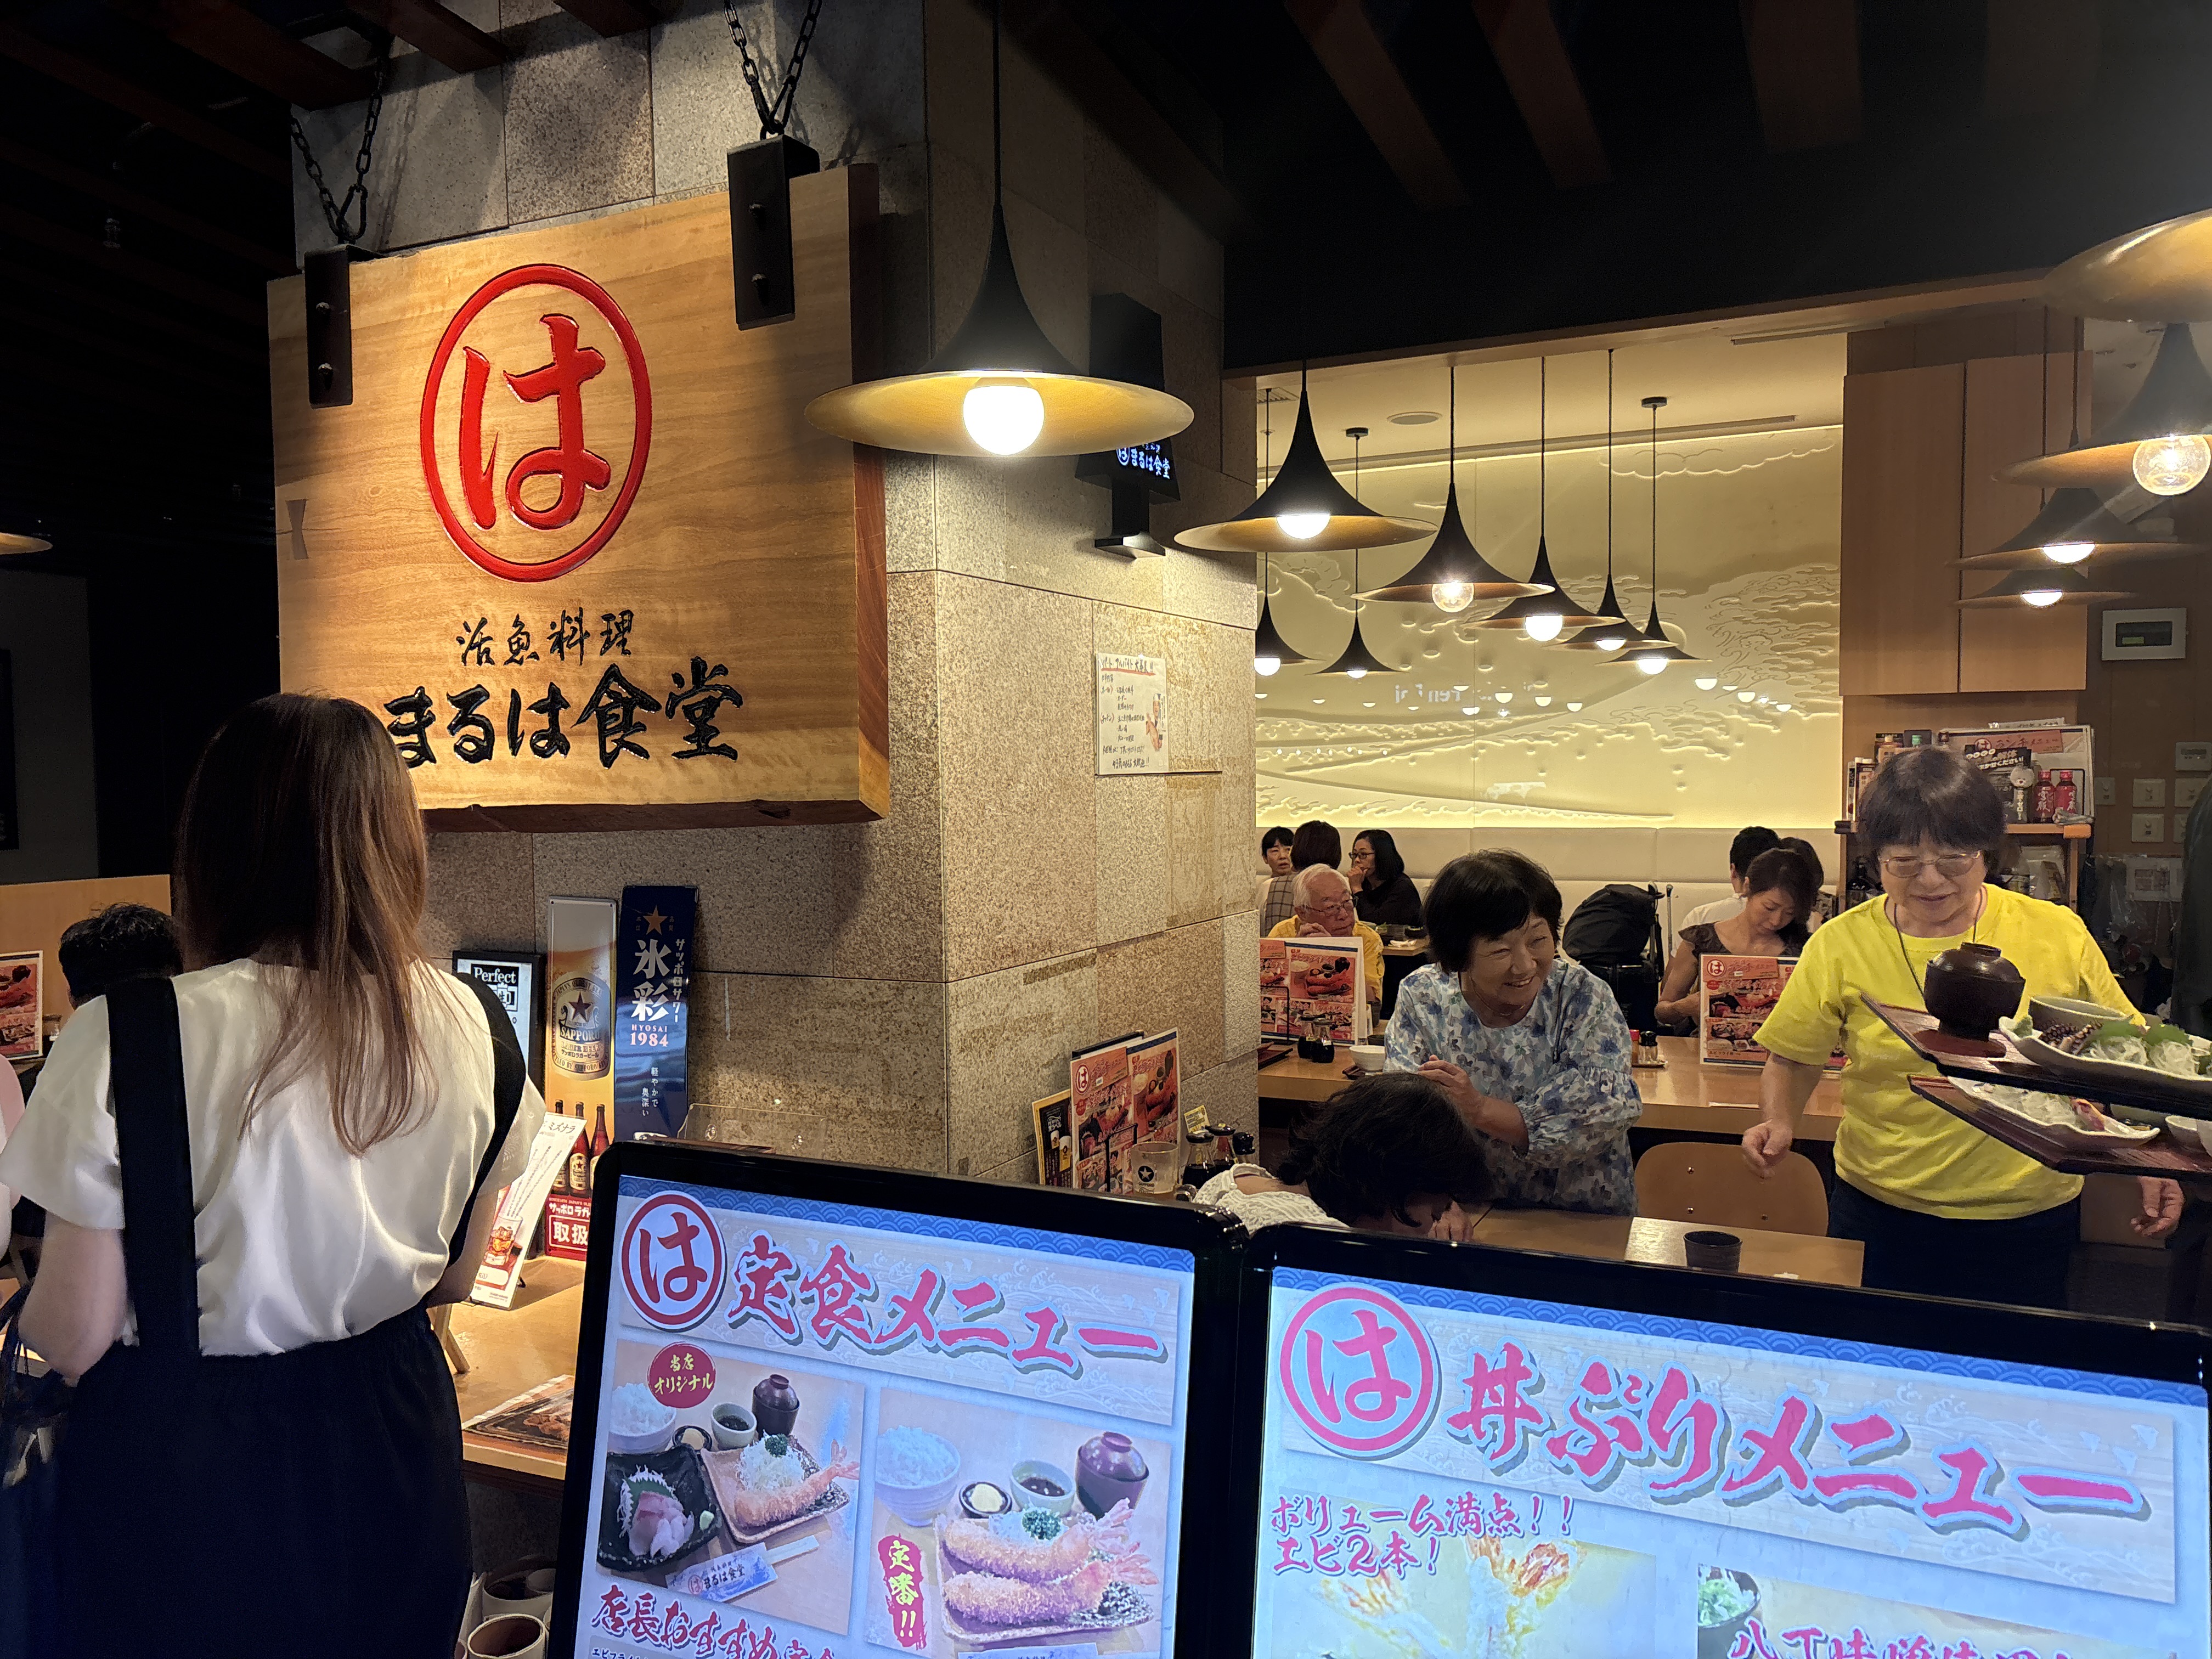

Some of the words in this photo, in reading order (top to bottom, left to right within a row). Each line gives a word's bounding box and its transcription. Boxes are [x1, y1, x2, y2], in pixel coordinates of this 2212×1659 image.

[1130, 448, 1170, 479] まるは食堂
[456, 607, 634, 666] 活魚料理
[382, 657, 744, 769] まるは食堂
[473, 967, 516, 984] Perfect
[631, 939, 672, 1021] 氷彩
[673, 939, 685, 1023] サッポロサワー
[630, 1032, 669, 1047] 1984
[632, 1024, 667, 1032] HYOSAI
[641, 1087, 650, 1116] 奥深い
[549, 1203, 591, 1218] サッポロラガ
[553, 1221, 588, 1245] 取扱
[728, 1233, 1162, 1372] 定食メニュー
[670, 1352, 694, 1372] 当店
[654, 1373, 713, 1395] オリジナル
[1448, 1342, 2140, 1534] 丼ぶりメニュー
[1271, 1491, 1572, 1535] ボリューム満点！！
[1273, 1532, 1438, 1576] エビ2本！
[703, 1564, 745, 1589] まるは食堂
[888, 1539, 919, 1638] 定番!!
[592, 1584, 834, 1659] 店長おすすめ
